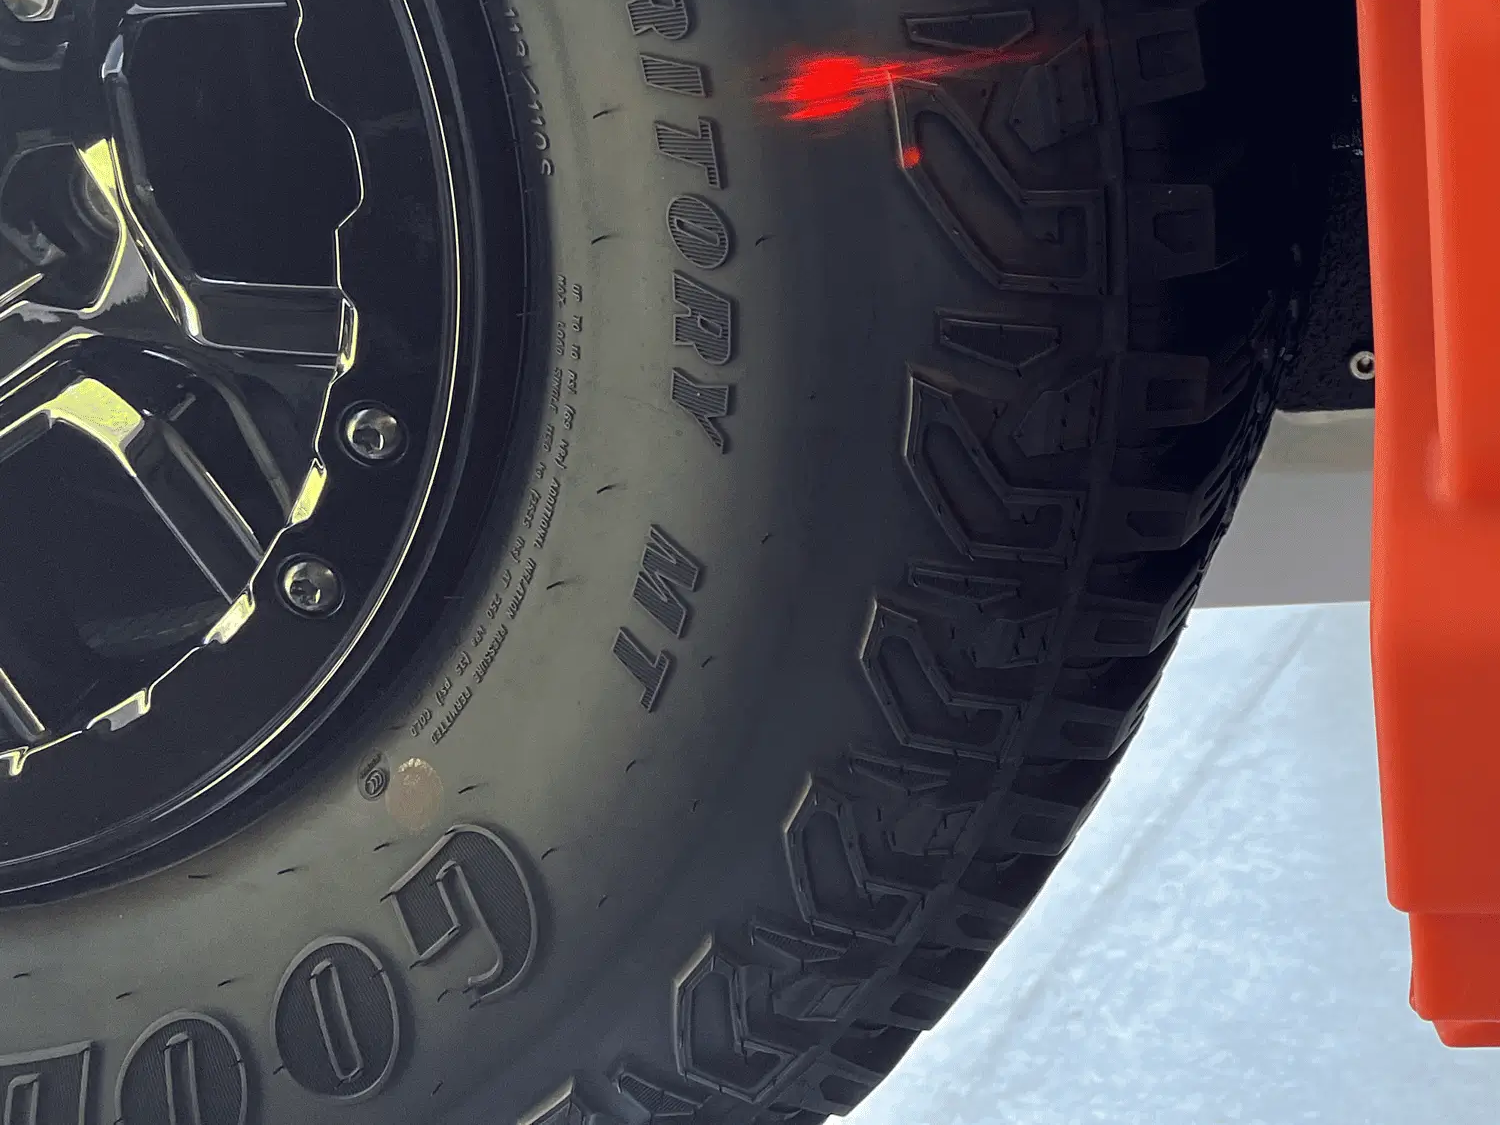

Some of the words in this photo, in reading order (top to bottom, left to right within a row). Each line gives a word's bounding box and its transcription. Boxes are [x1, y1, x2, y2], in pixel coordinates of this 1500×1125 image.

[557, 274, 567, 306] MAX
[571, 283, 583, 303] UP
[555, 321, 566, 356] LOAD
[571, 315, 583, 333] TO
[547, 367, 563, 415] SINGLE
[532, 477, 562, 550] ADDITIONAL
[505, 557, 537, 620] INFLATION
[611, 523, 704, 714] MT
[472, 623, 509, 684] PRESSURE
[408, 707, 433, 738] COLD
[430, 685, 473, 746] PERMITTED
